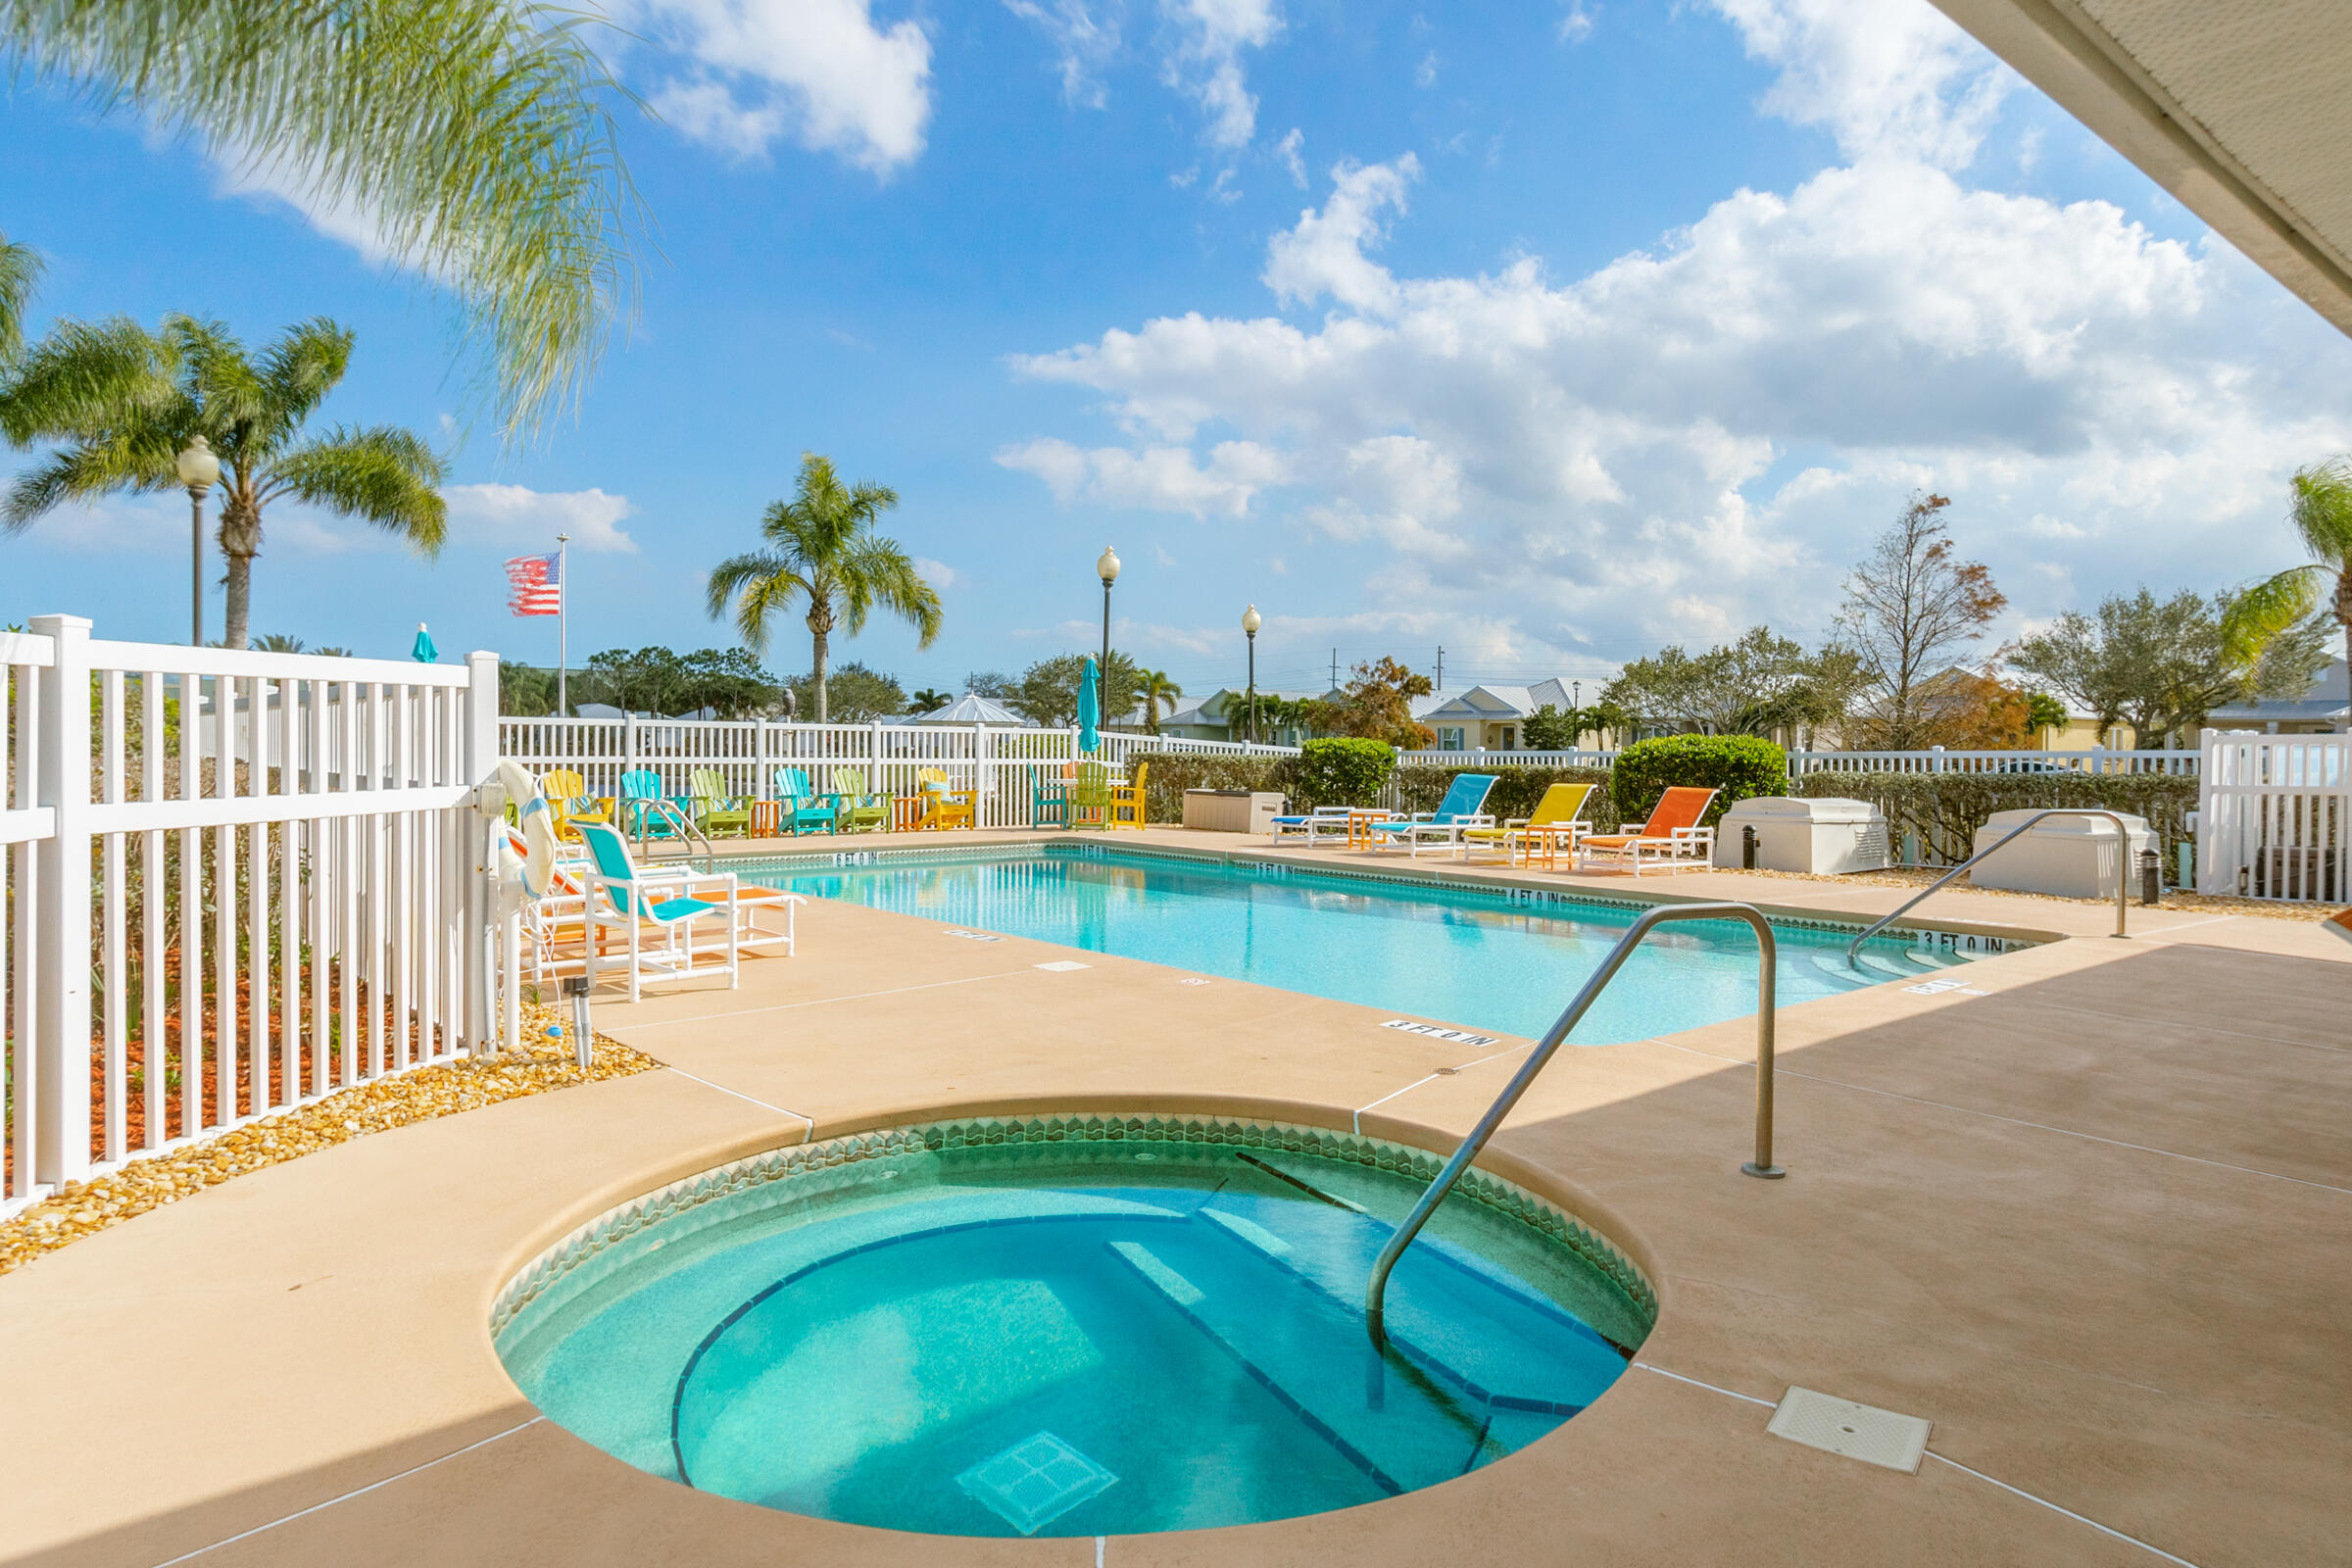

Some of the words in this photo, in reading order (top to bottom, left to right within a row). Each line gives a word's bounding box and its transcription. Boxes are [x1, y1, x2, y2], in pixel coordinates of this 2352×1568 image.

[868, 851, 877, 863] IN
[1520, 889, 1532, 901] FT
[1547, 892, 1558, 903] IN
[1940, 933, 1959, 946] FT
[1967, 936, 1976, 949] 0
[1985, 937, 2002, 951] IN
[1406, 1024, 1444, 1034] FT
[1460, 1035, 1495, 1046] IN
